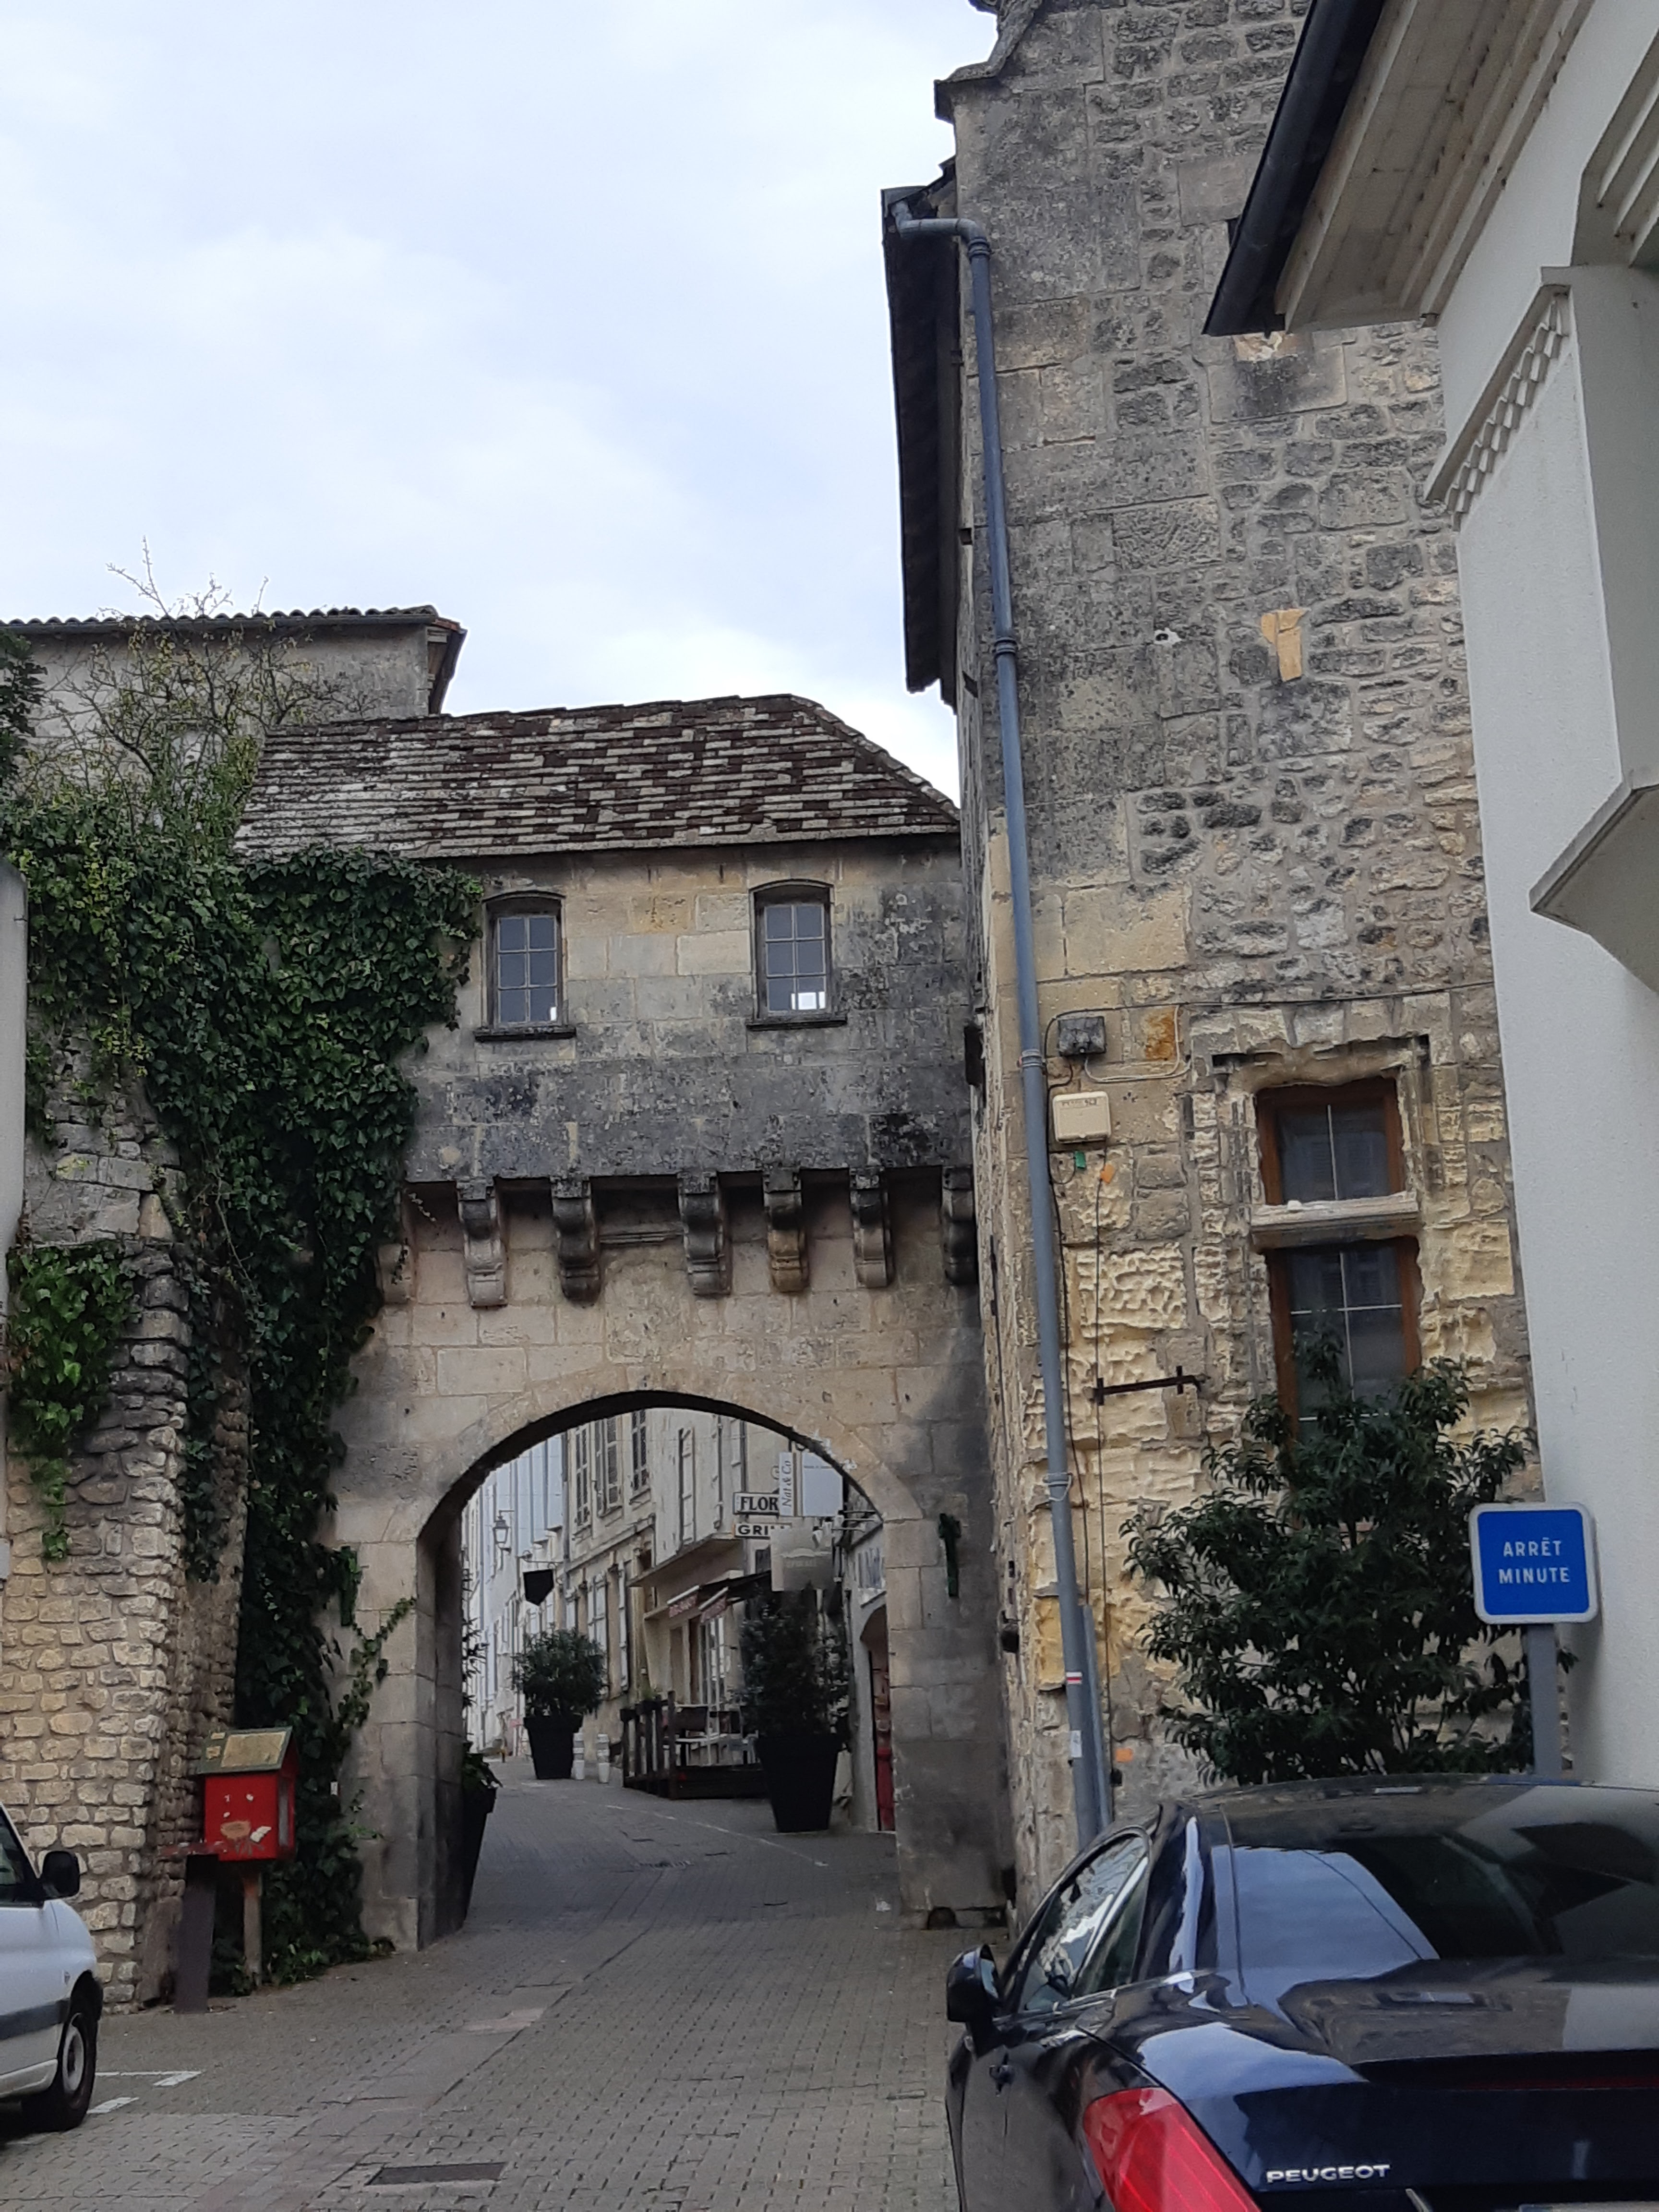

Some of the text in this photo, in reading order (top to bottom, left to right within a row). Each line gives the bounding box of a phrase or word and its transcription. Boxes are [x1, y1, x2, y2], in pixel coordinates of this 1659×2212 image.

[1503, 1537, 1561, 1557] ARRÊT
[1498, 1567, 1570, 1584] MINUTE
[1266, 2164, 1390, 2183] PEUGEOT
